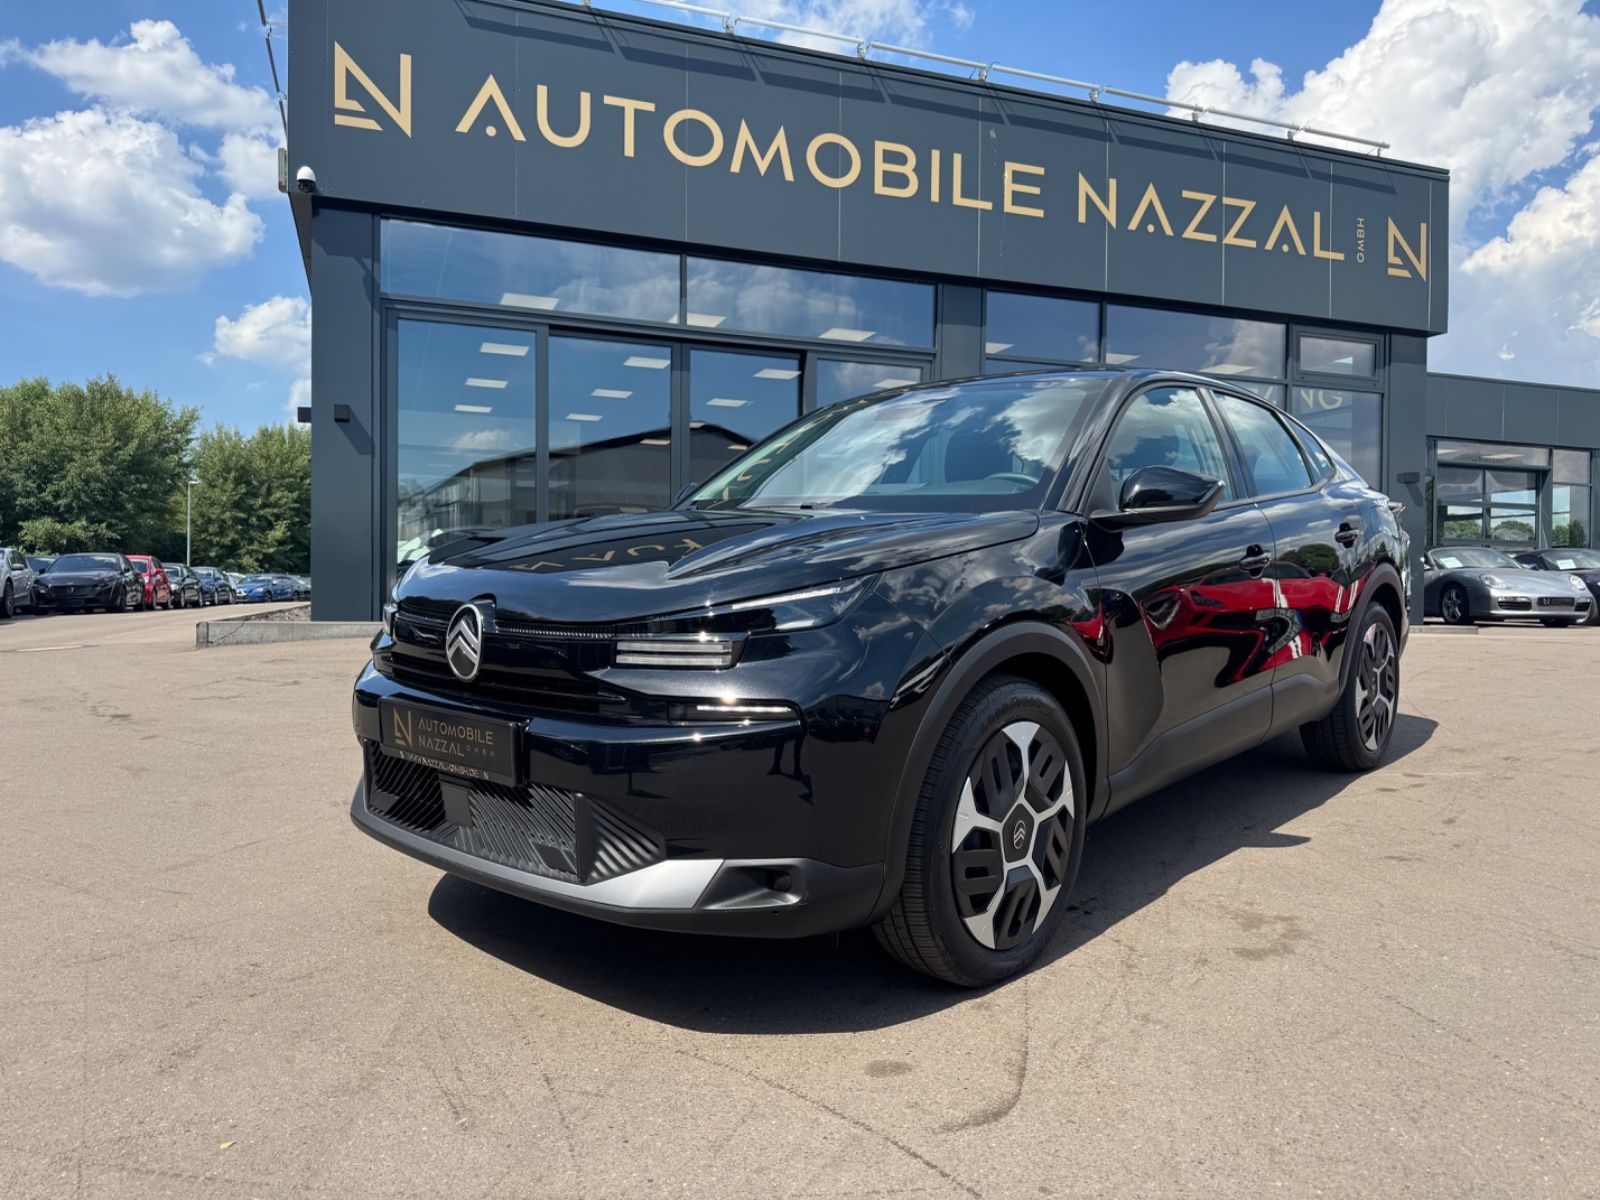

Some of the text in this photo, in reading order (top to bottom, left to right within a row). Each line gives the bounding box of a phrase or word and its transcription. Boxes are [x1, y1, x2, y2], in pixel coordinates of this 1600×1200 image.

[455, 73, 1345, 261] AUTOMOBILE NAZZAL
[1356, 217, 1365, 264] GMBH
[418, 717, 494, 745] AUTOMOBILE
[418, 736, 465, 757] NAZZAL
